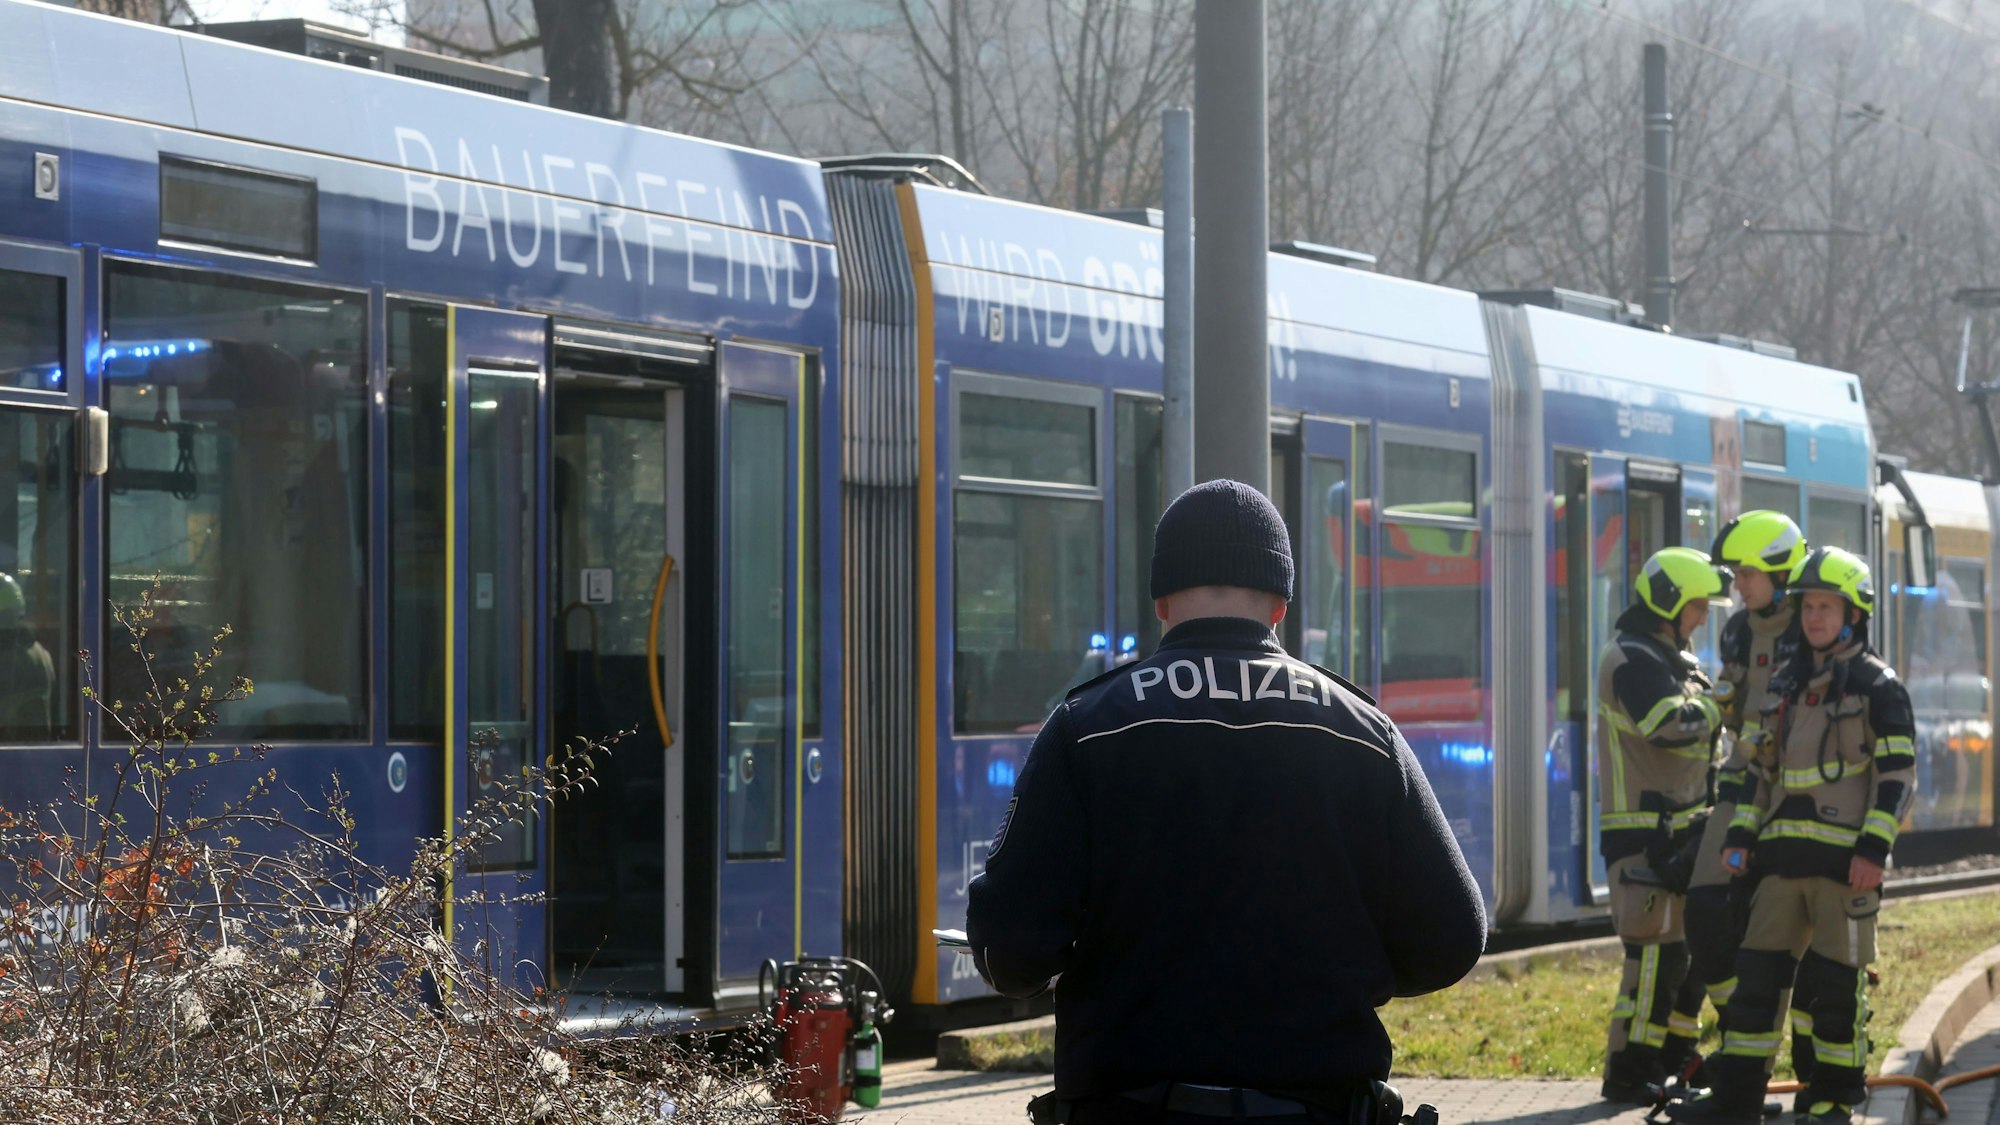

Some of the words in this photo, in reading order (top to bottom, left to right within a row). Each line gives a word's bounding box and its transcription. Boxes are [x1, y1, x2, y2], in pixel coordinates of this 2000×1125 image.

[394, 126, 819, 309] BAUERFEIND
[941, 231, 1072, 349] WIRD
[1130, 656, 1332, 707] POLIZEI
